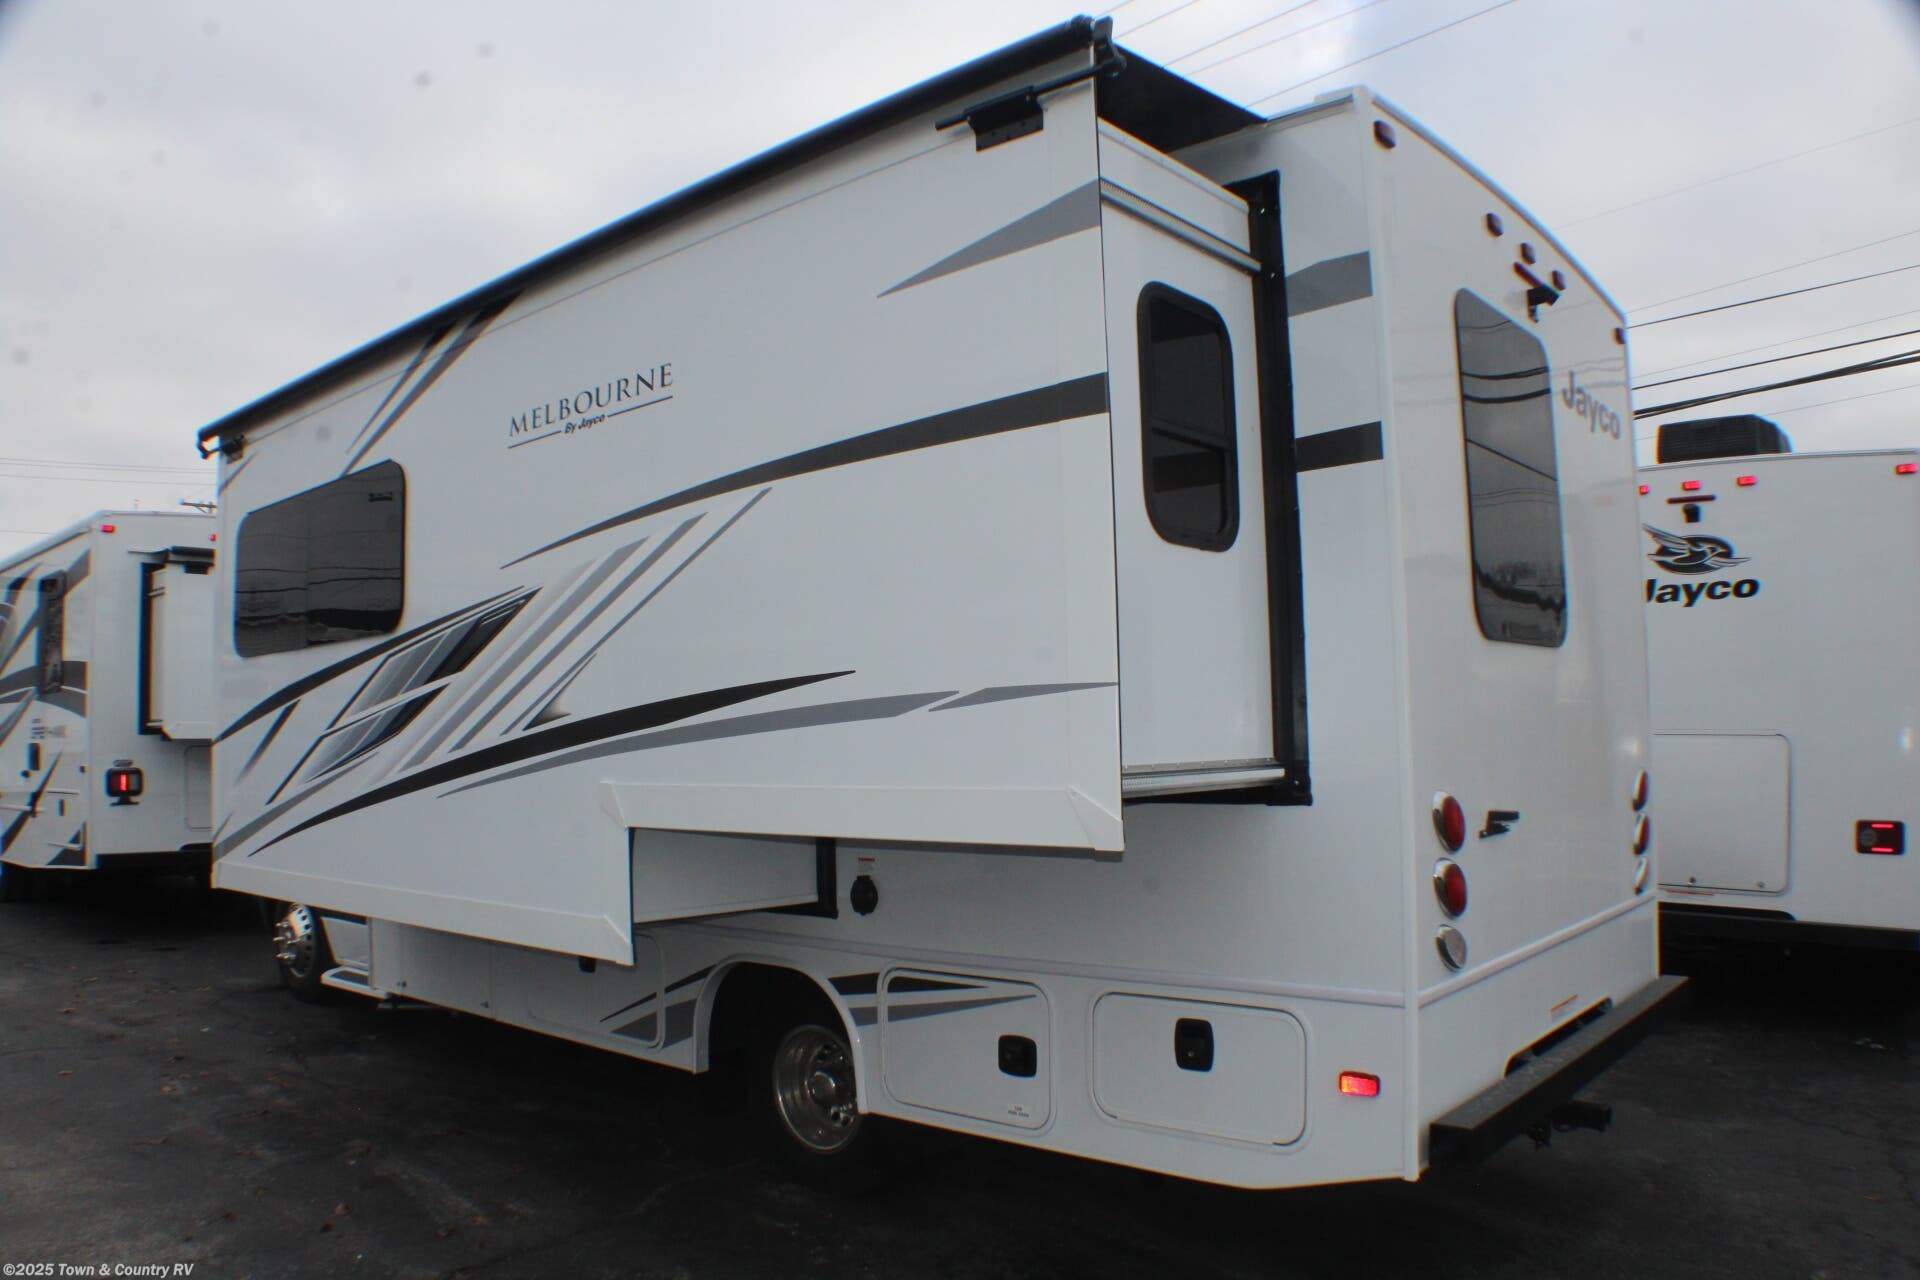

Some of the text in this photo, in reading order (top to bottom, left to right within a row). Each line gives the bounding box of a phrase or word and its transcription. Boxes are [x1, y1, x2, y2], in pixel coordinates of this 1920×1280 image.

[508, 362, 673, 437] MELBOURNE
[564, 413, 606, 434] By Jayco
[1562, 370, 1621, 440] Jayco
